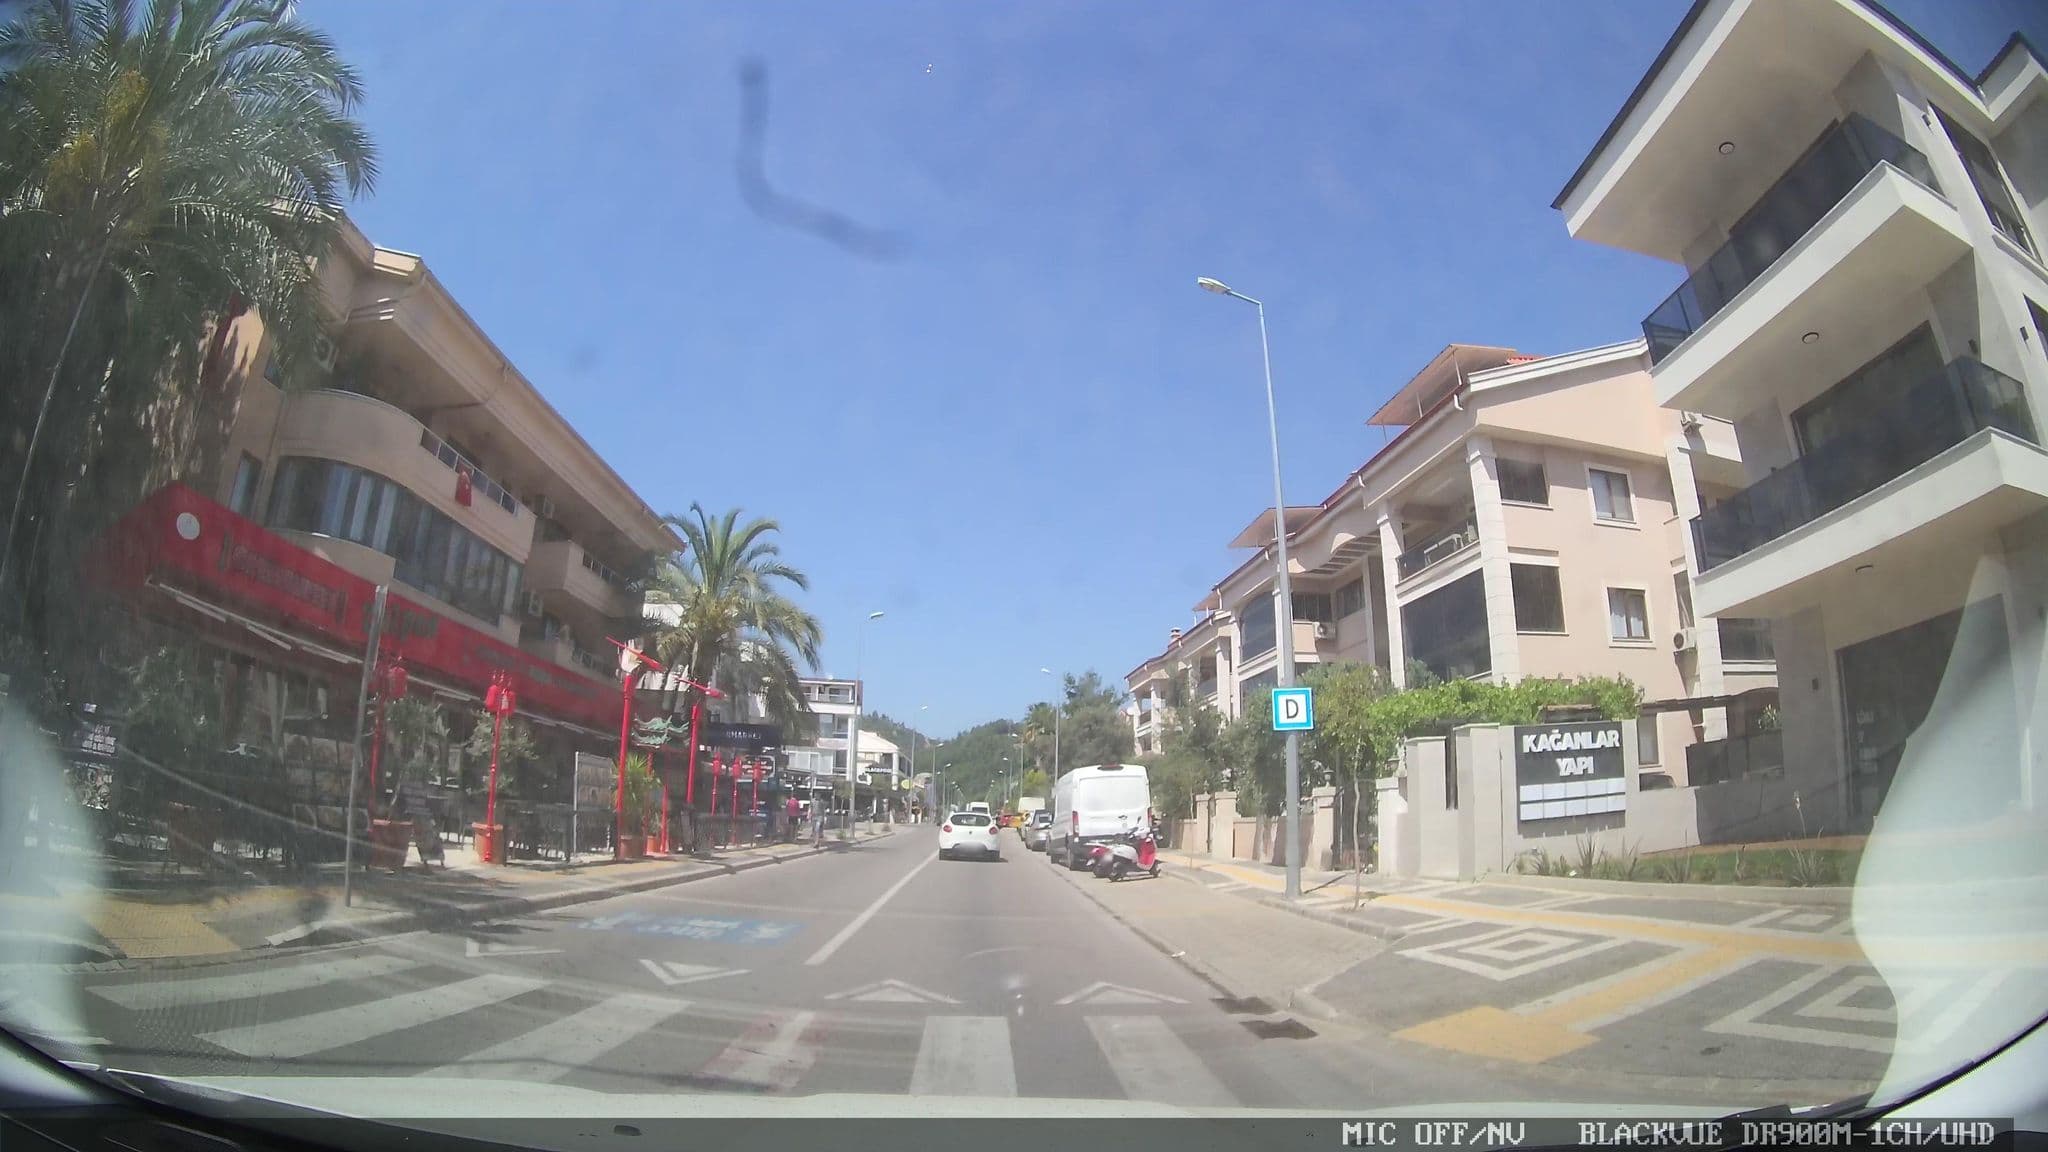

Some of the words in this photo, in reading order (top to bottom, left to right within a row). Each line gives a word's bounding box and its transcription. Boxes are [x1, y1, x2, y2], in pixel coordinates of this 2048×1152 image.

[1286, 699, 1299, 719] D
[1523, 729, 1620, 752] KAĞANLAR
[1556, 756, 1594, 776] YAPI
